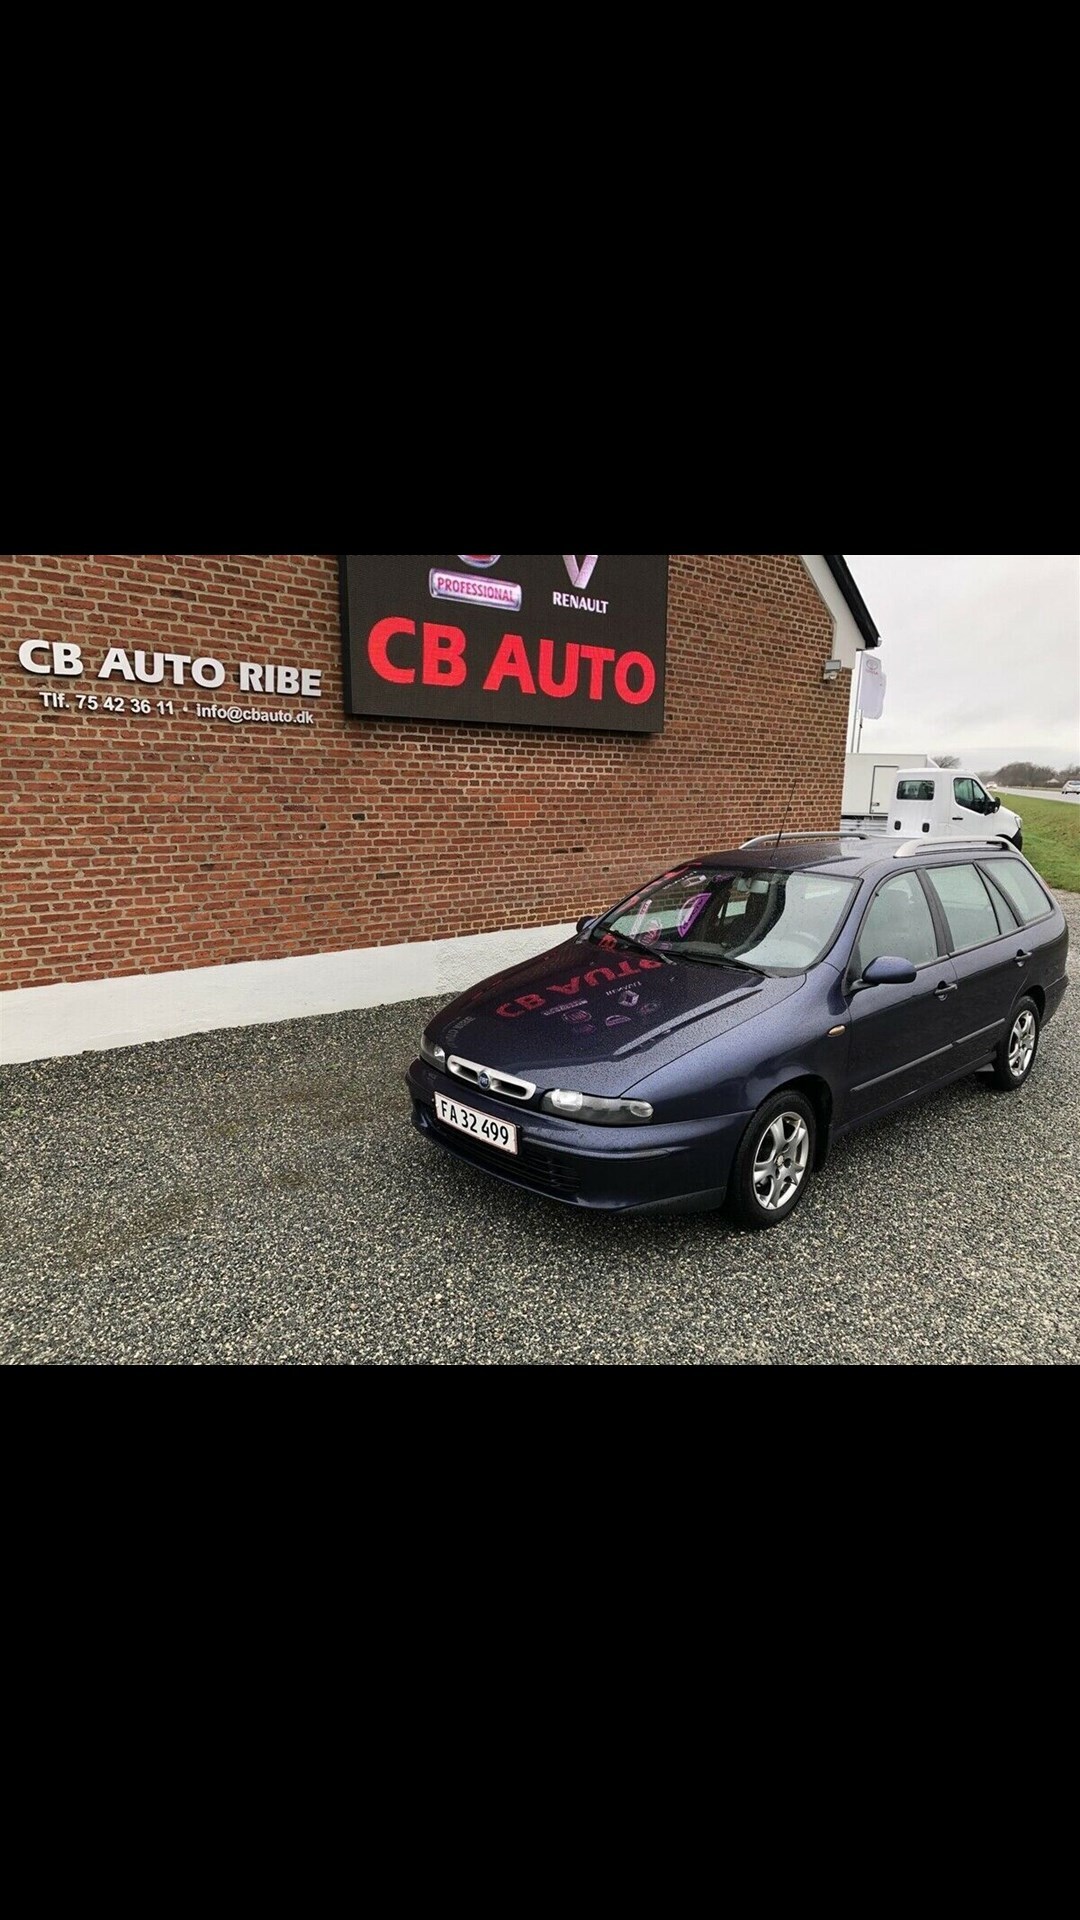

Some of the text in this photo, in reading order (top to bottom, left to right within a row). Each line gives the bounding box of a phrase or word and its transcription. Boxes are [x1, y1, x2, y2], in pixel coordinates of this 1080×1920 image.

[436, 576, 516, 602] PROFESSIONAL
[552, 591, 609, 614] RENAULT
[18, 639, 322, 697] CB AUTO RIBE
[367, 616, 656, 705] CB AUTO
[39, 691, 315, 724] Tlf. 75 42 36 11 info@cbauto.dk
[441, 1100, 509, 1145] FA 32 499
